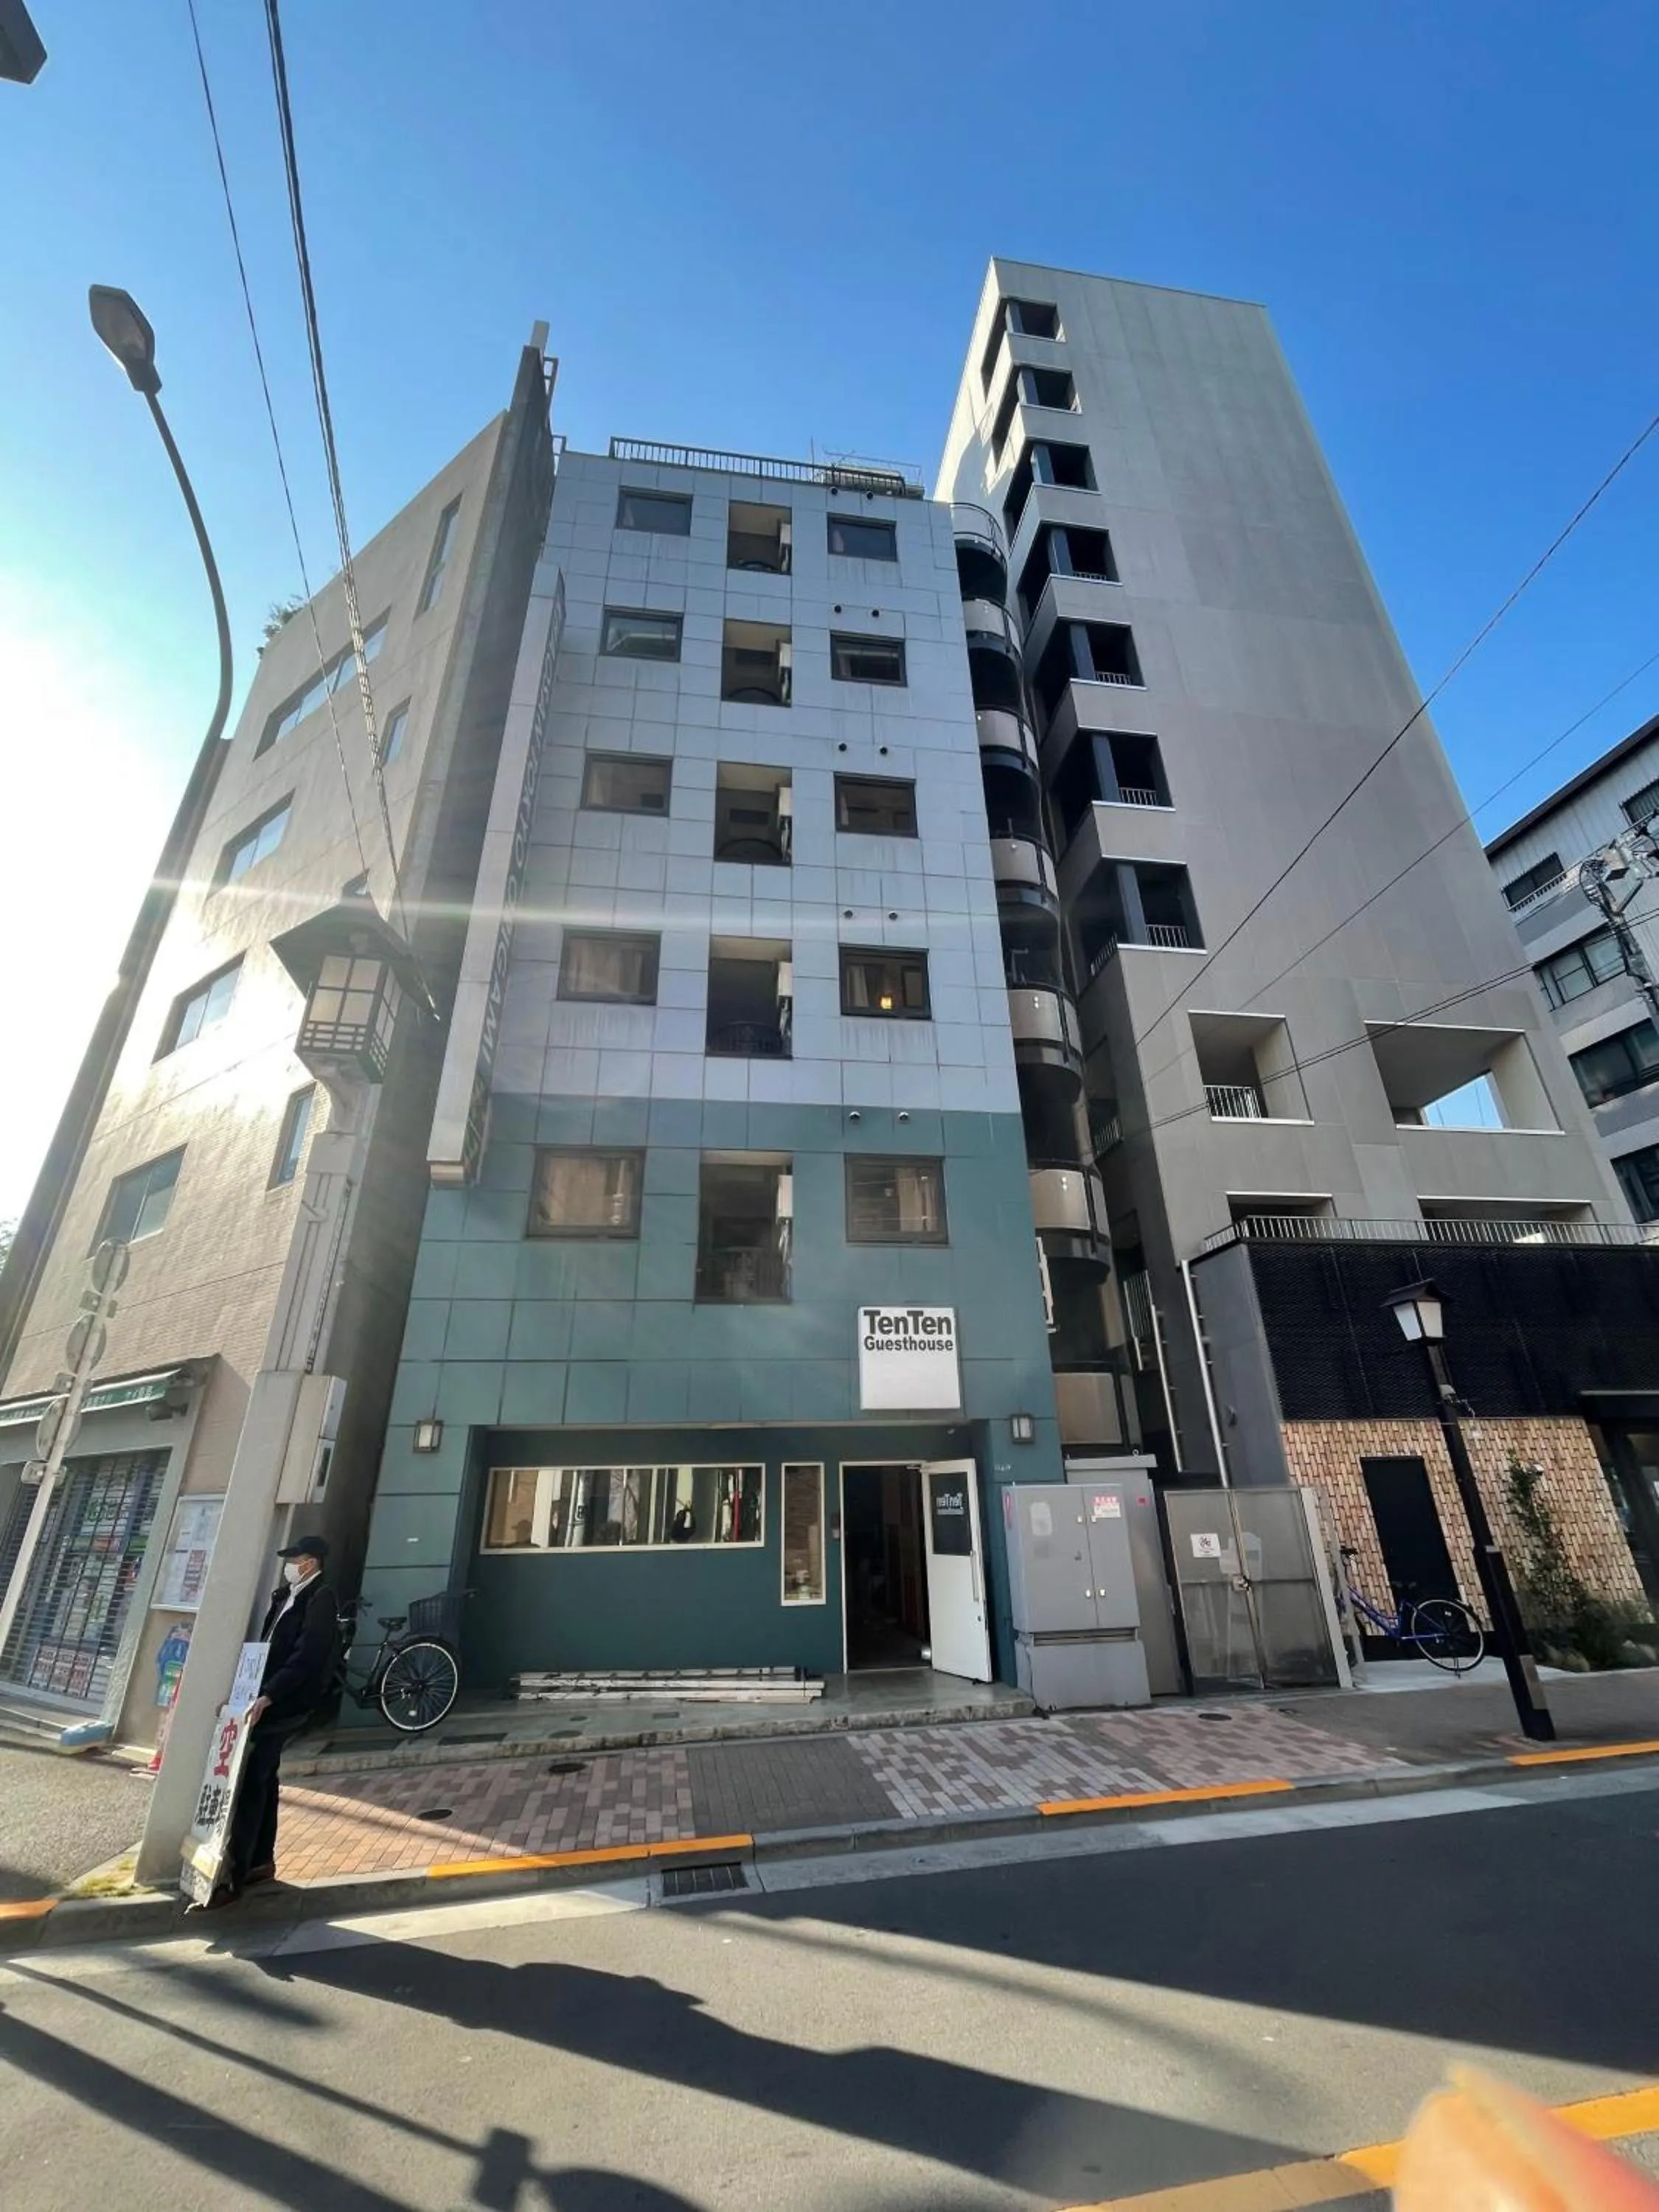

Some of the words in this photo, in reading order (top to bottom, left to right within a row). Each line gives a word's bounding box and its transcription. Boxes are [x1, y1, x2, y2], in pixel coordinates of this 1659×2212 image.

[863, 1310, 952, 1335] TenTen
[864, 1335, 953, 1352] Guesthouse
[213, 1717, 238, 1778] 空
